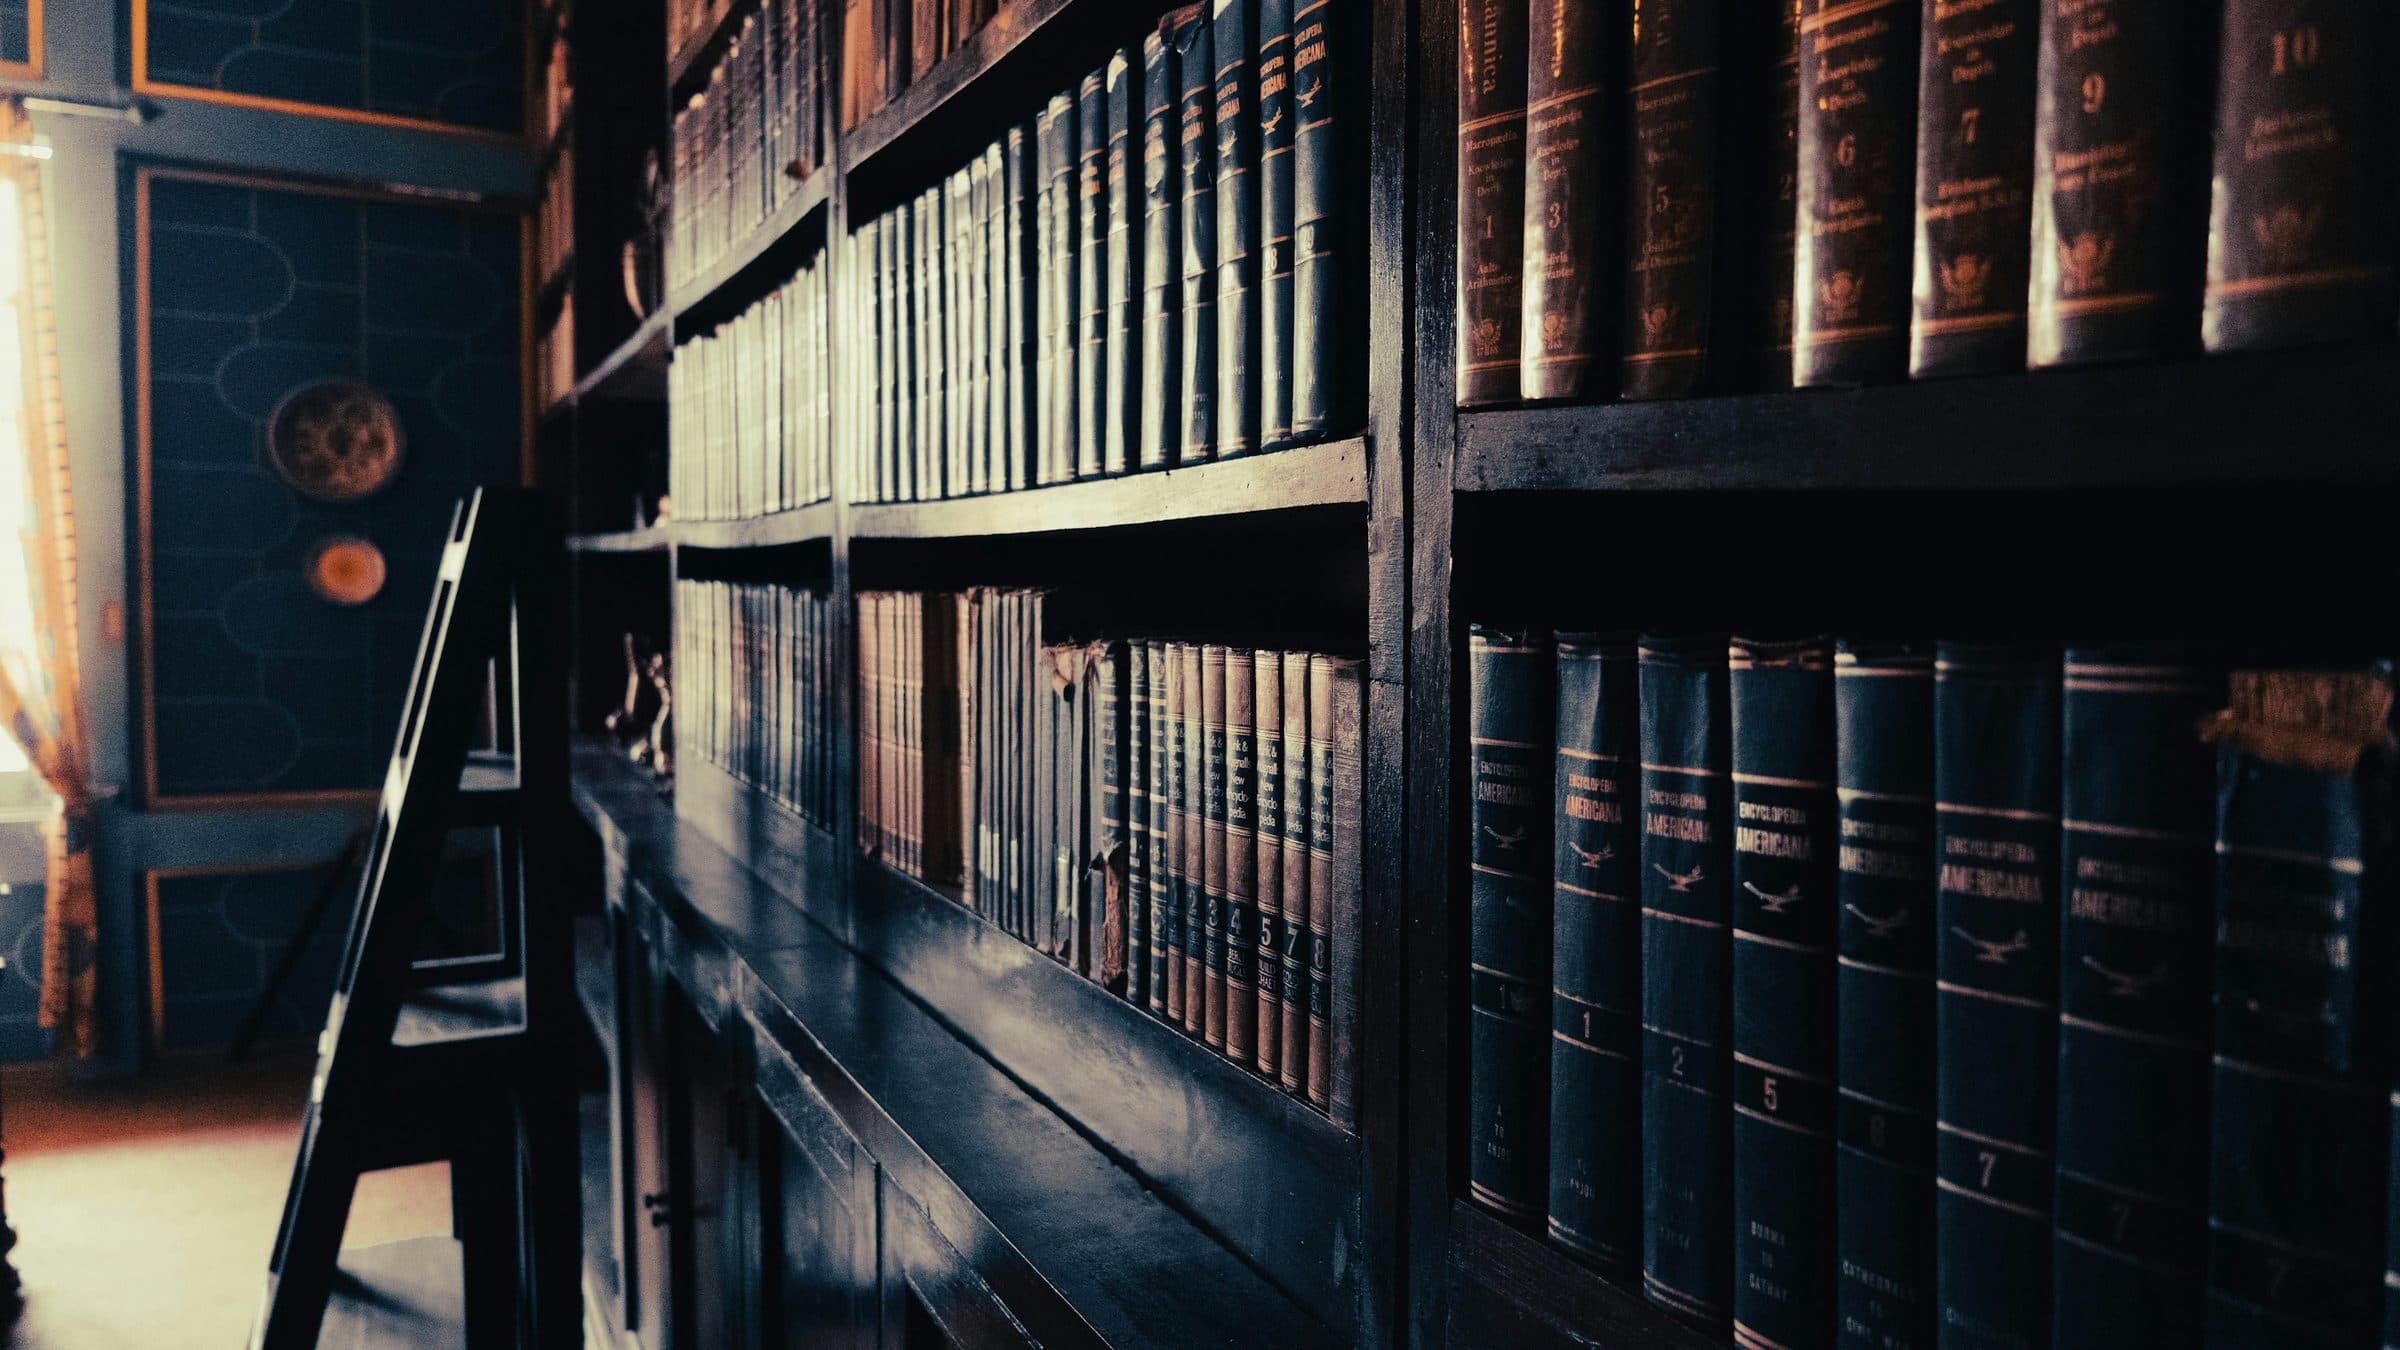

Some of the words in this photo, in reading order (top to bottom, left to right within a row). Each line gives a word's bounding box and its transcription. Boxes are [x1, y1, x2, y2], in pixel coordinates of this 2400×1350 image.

[2272, 26, 2321, 75] 10
[2081, 72, 2106, 113] 9
[1961, 107, 1981, 145] 7
[1836, 133, 1857, 167] 6
[1655, 186, 1670, 214] 5
[1484, 215, 1494, 239] 1
[1549, 203, 1562, 229] 3
[1565, 794, 1623, 824] AMERICANA
[1739, 801, 1807, 825] ENCYCLOPEDIA
[1646, 812, 1712, 843] AMERICANA
[1736, 826, 1814, 862] AMERICANA
[1939, 864, 2044, 904] AMERICANA
[1188, 889, 1198, 915] 2
[1208, 898, 1218, 927] 3
[1231, 908, 1242, 935] 4
[1261, 916, 1272, 946] 5
[1287, 926, 1299, 956] 7
[1314, 938, 1326, 969] 8
[1583, 1011, 1592, 1039] 1
[1671, 1046, 1683, 1076] 2
[1763, 1077, 1778, 1111] 5
[1978, 1151, 1996, 1189] 7
